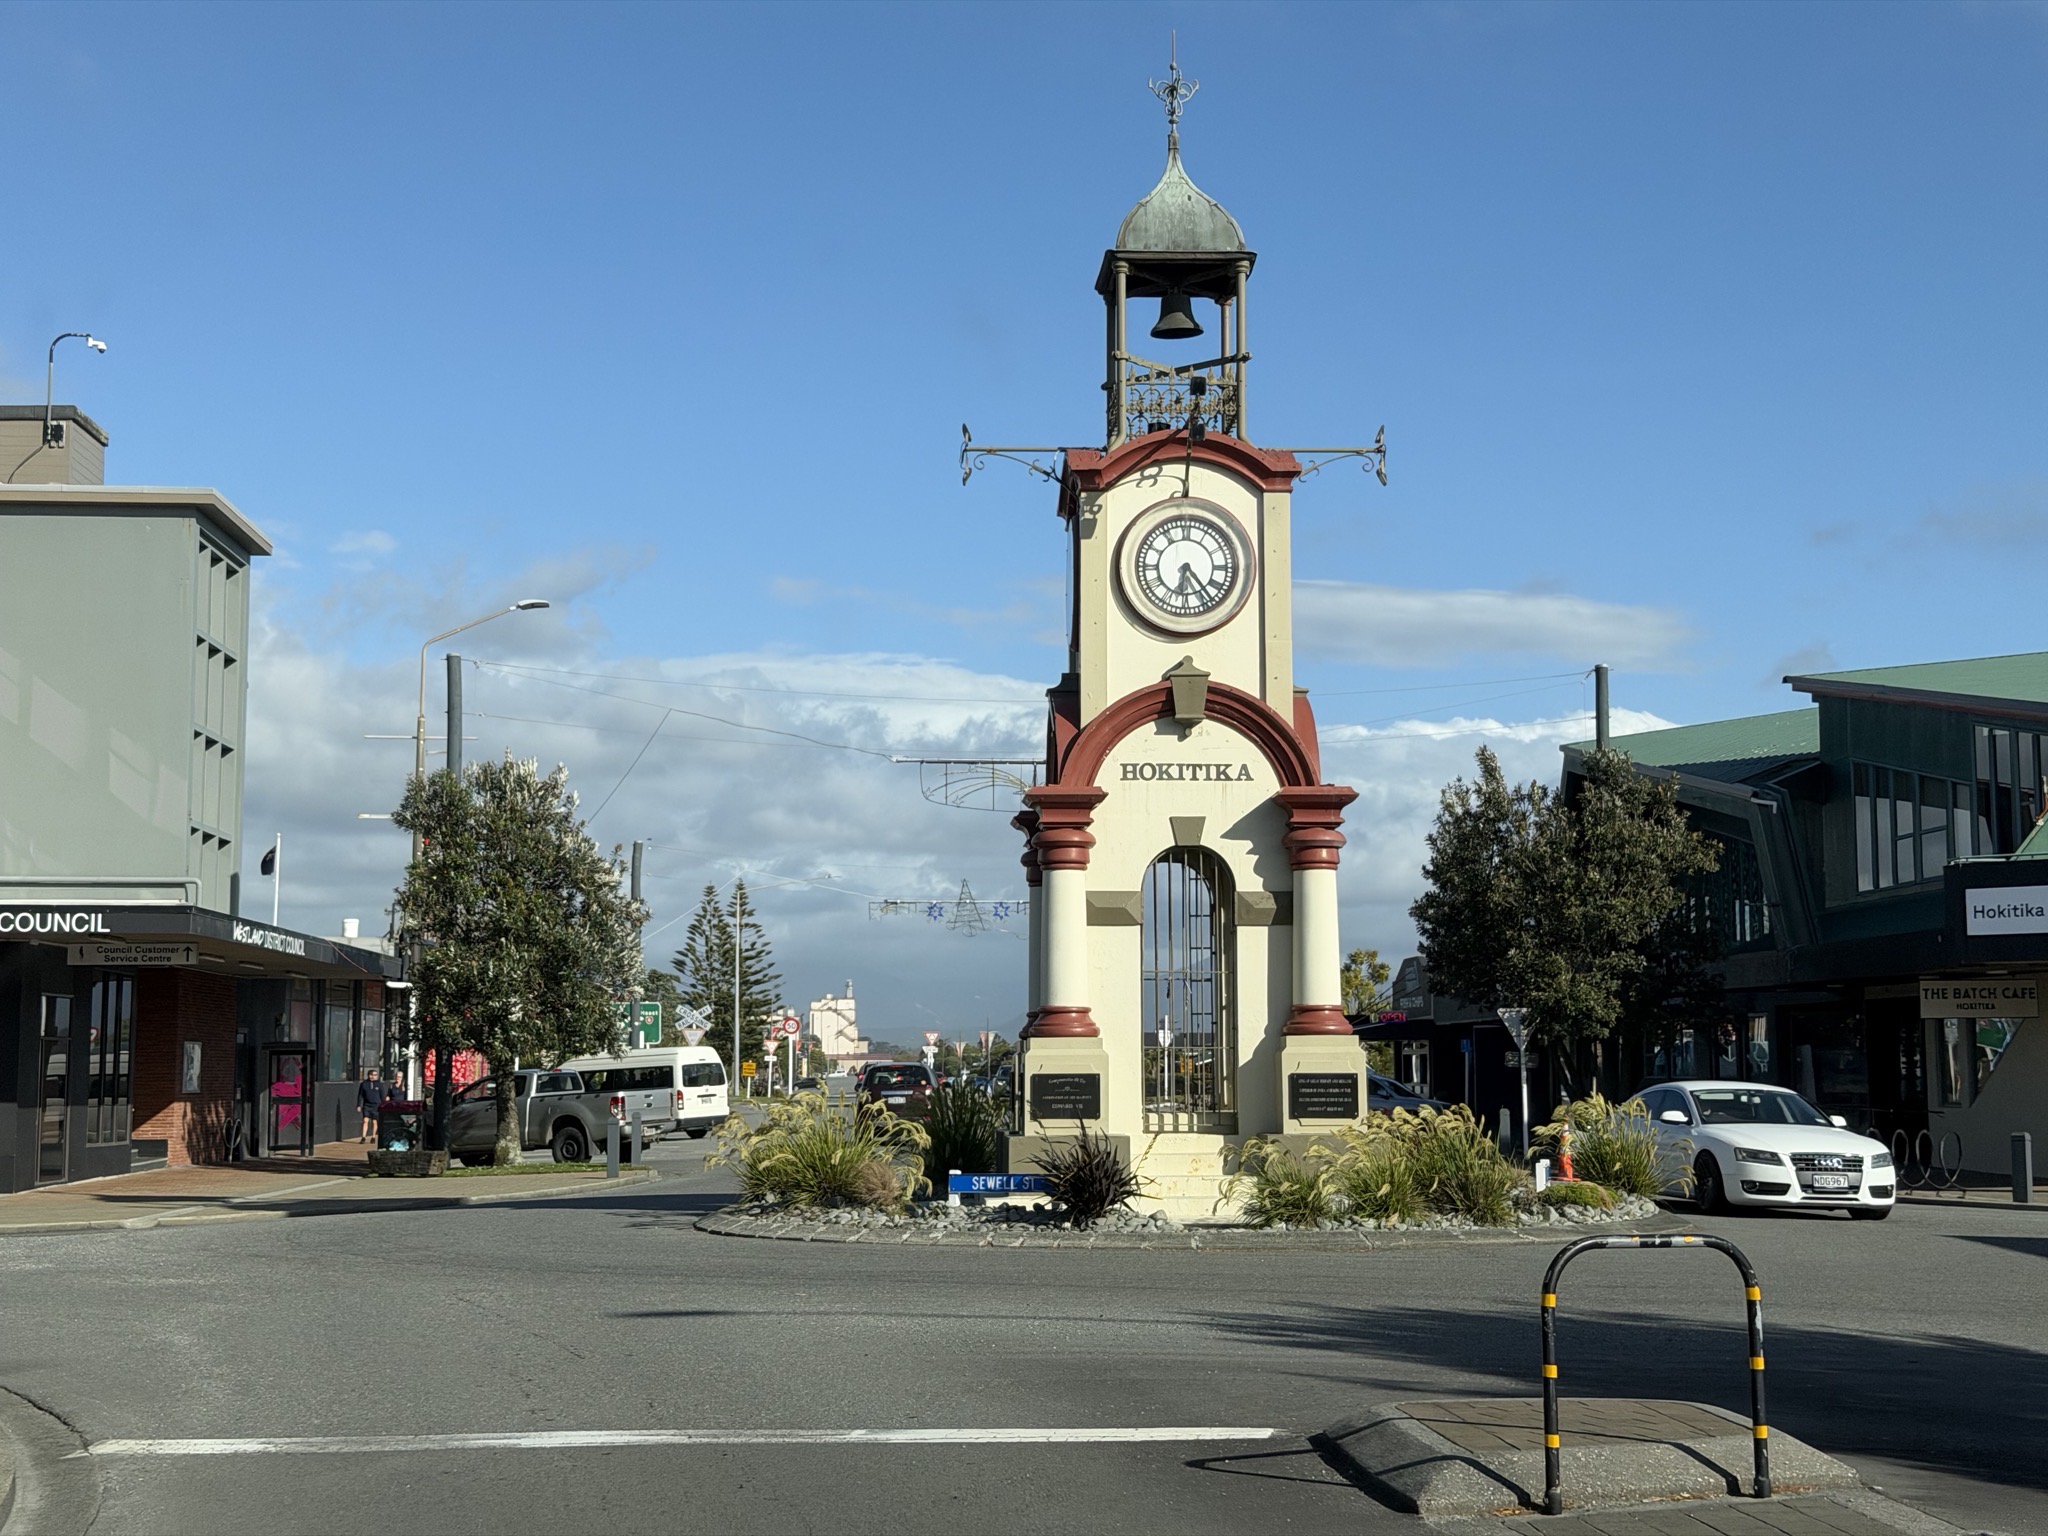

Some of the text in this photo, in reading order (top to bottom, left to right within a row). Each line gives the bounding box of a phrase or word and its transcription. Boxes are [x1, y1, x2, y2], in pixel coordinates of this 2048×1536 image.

[1120, 762, 1255, 781] HOKITIKA
[1973, 903, 2045, 919] Hokitika
[0, 912, 110, 933] COUNCIL
[233, 920, 264, 946] WESTLAND
[285, 935, 306, 956] COUNCIL
[97, 945, 180, 954] Council Customer
[104, 955, 172, 964] Service Centre
[1922, 987, 2036, 999] THE BATCH CAFE
[1956, 1002, 1996, 1010] HOKITIKA
[678, 1007, 708, 1028] CROSSING
[972, 1177, 1035, 1190] SEWELL ST
[1814, 1177, 1847, 1186] NDG967
